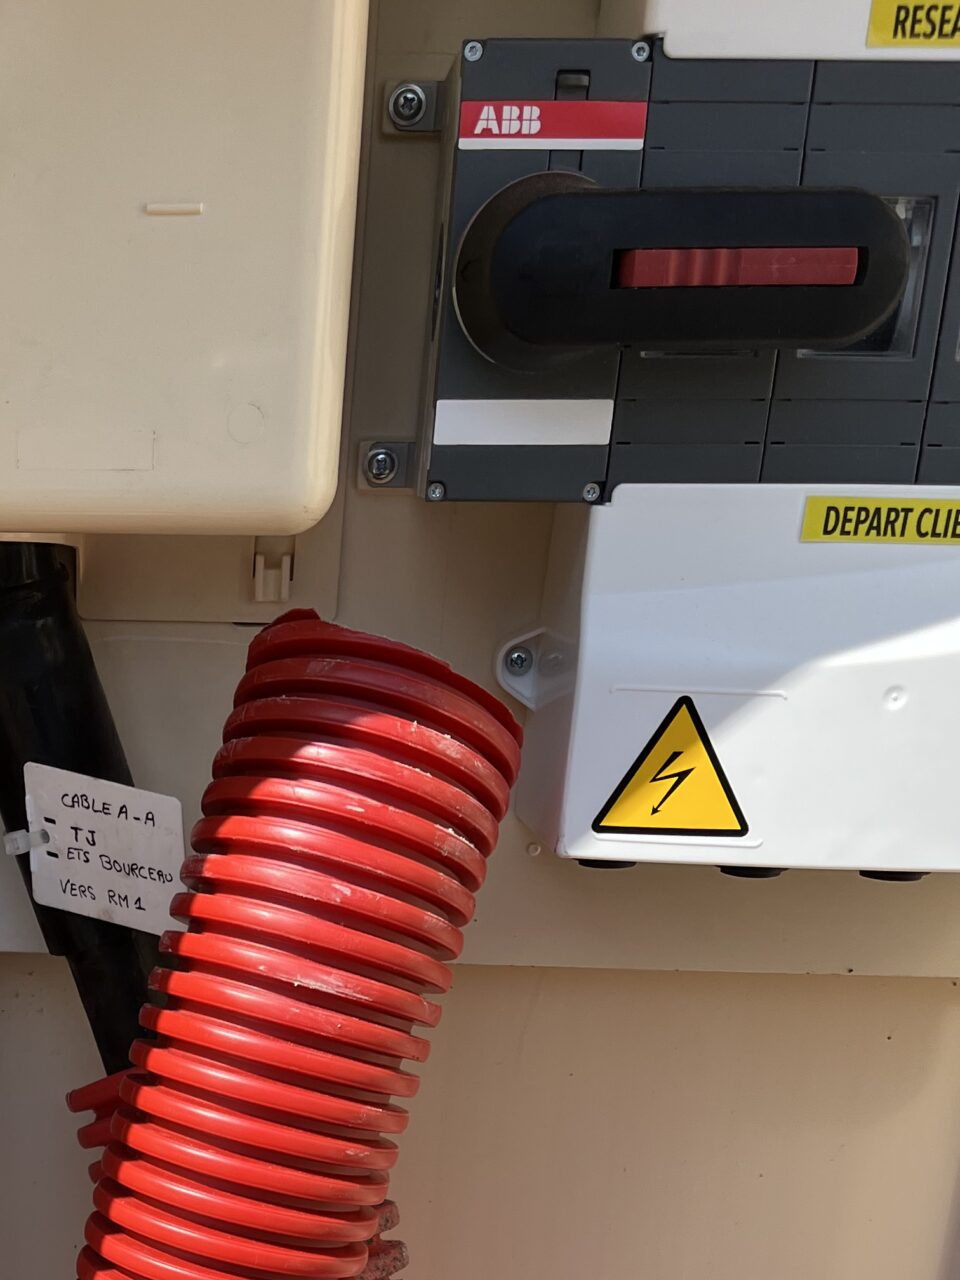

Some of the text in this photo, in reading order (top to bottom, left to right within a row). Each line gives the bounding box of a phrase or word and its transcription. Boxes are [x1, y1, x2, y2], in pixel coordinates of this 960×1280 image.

[474, 105, 541, 135] ABB
[822, 506, 914, 538] DEPART
[61, 793, 112, 815] CABLE
[66, 847, 90, 863] ETS
[59, 878, 96, 901] VERS
